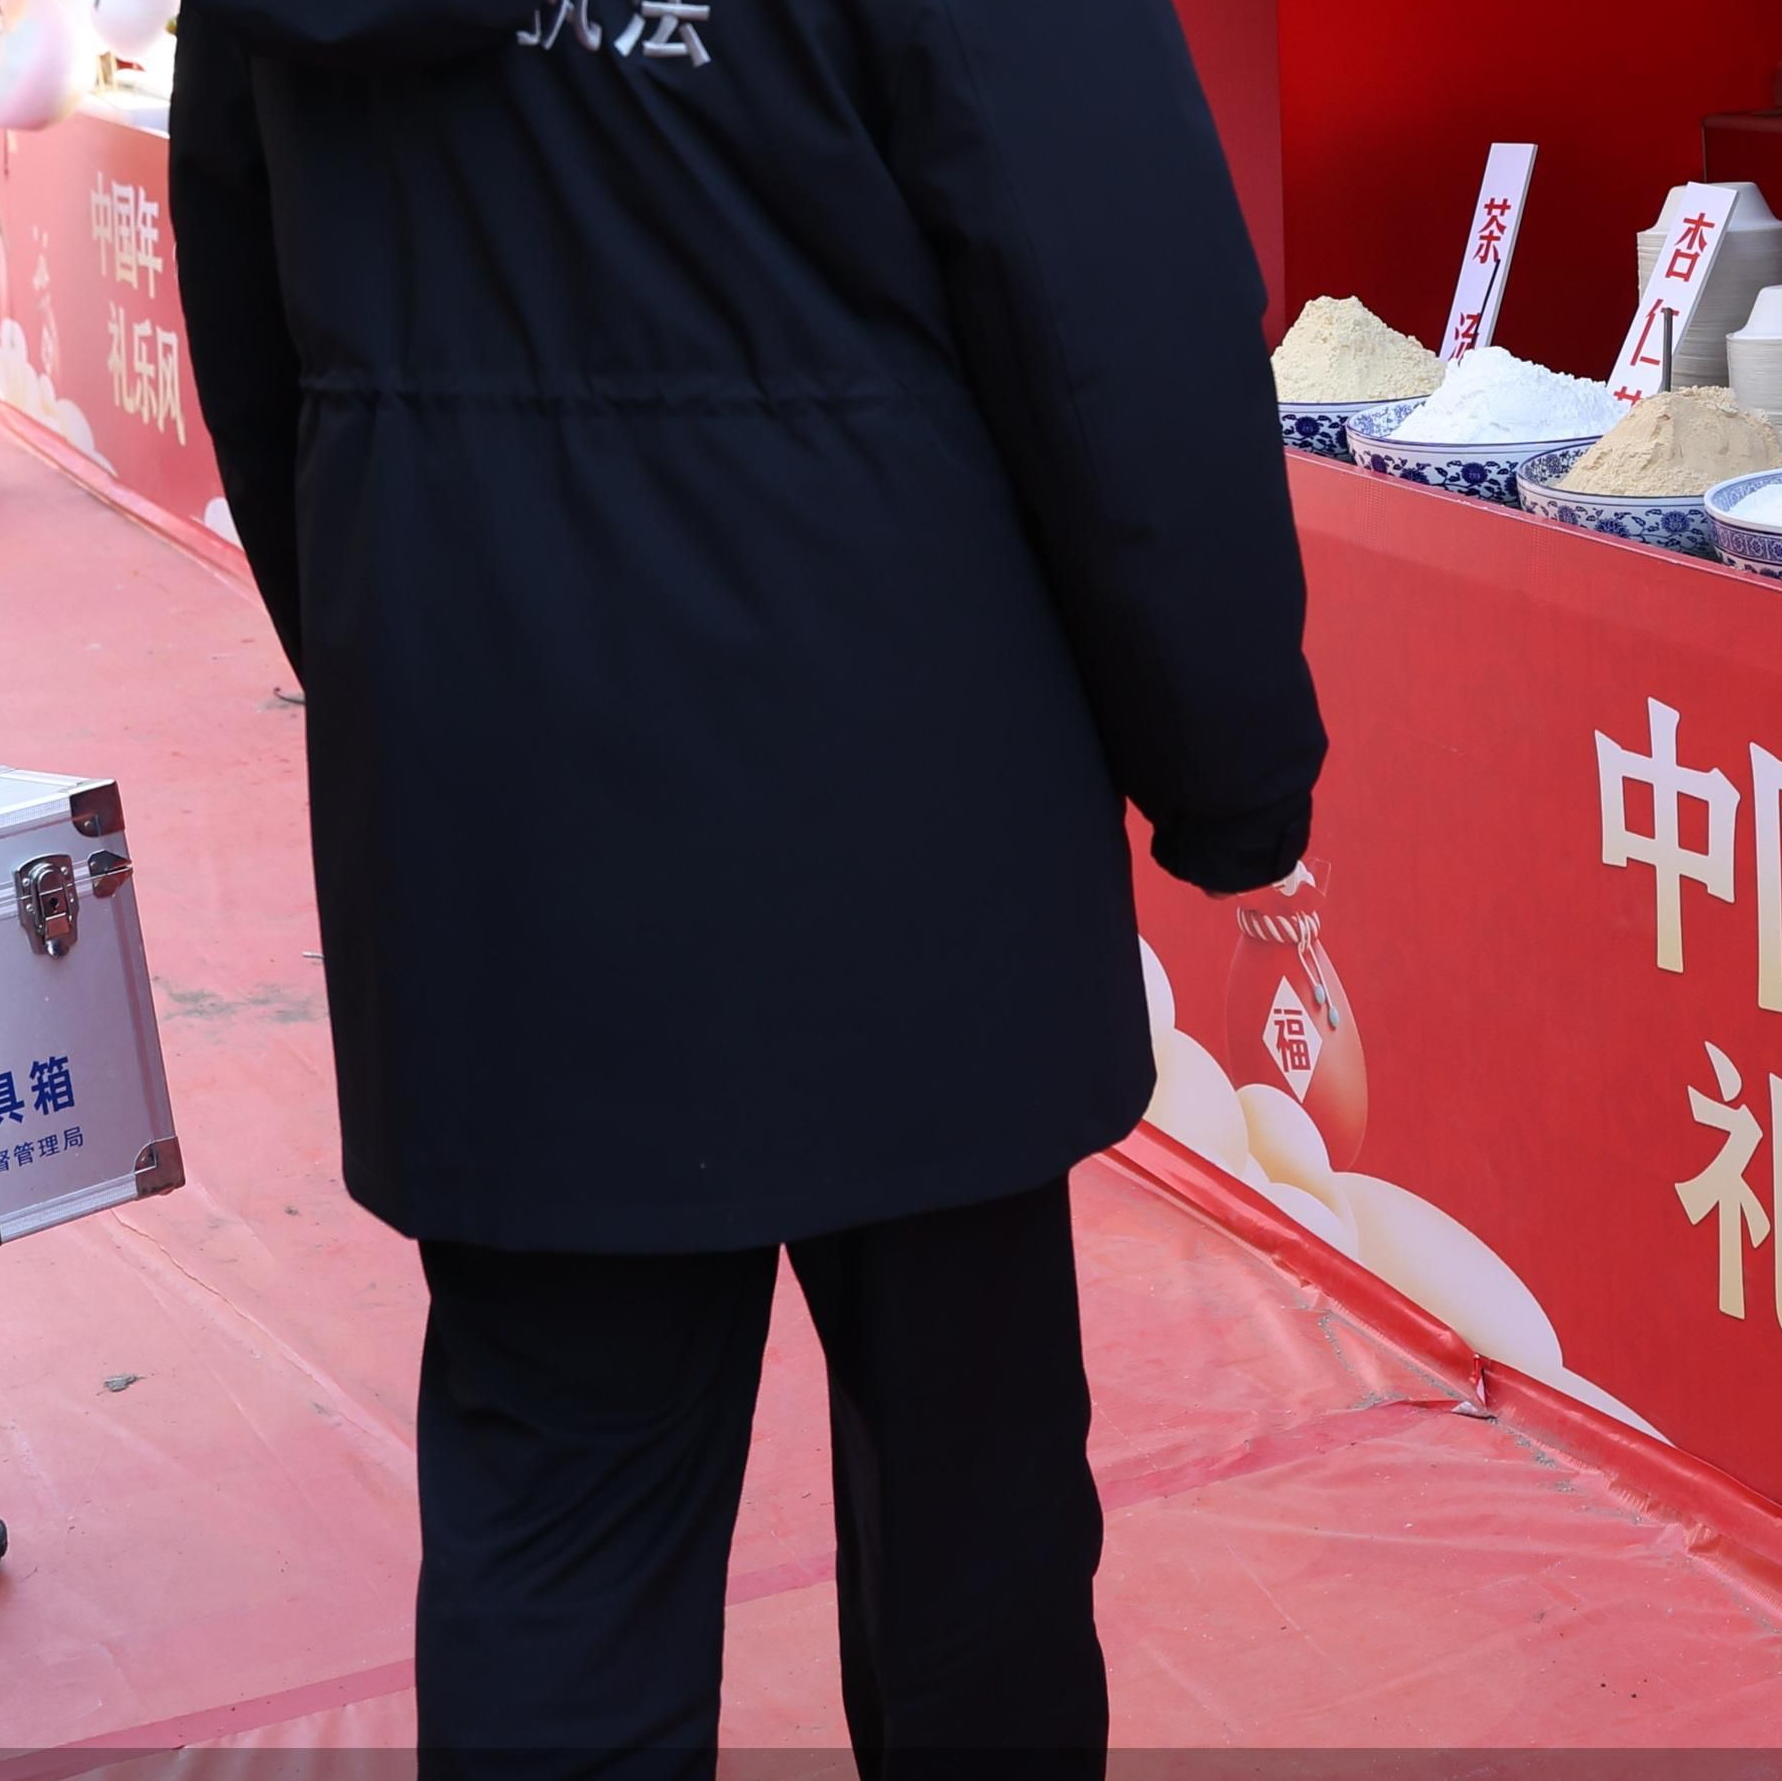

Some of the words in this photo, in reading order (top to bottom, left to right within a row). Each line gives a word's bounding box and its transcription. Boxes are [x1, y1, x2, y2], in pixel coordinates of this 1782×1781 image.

[90, 171, 163, 299] 中国年
[107, 301, 186, 447] 礼乐风
[1273, 1008, 1312, 1073] 福
